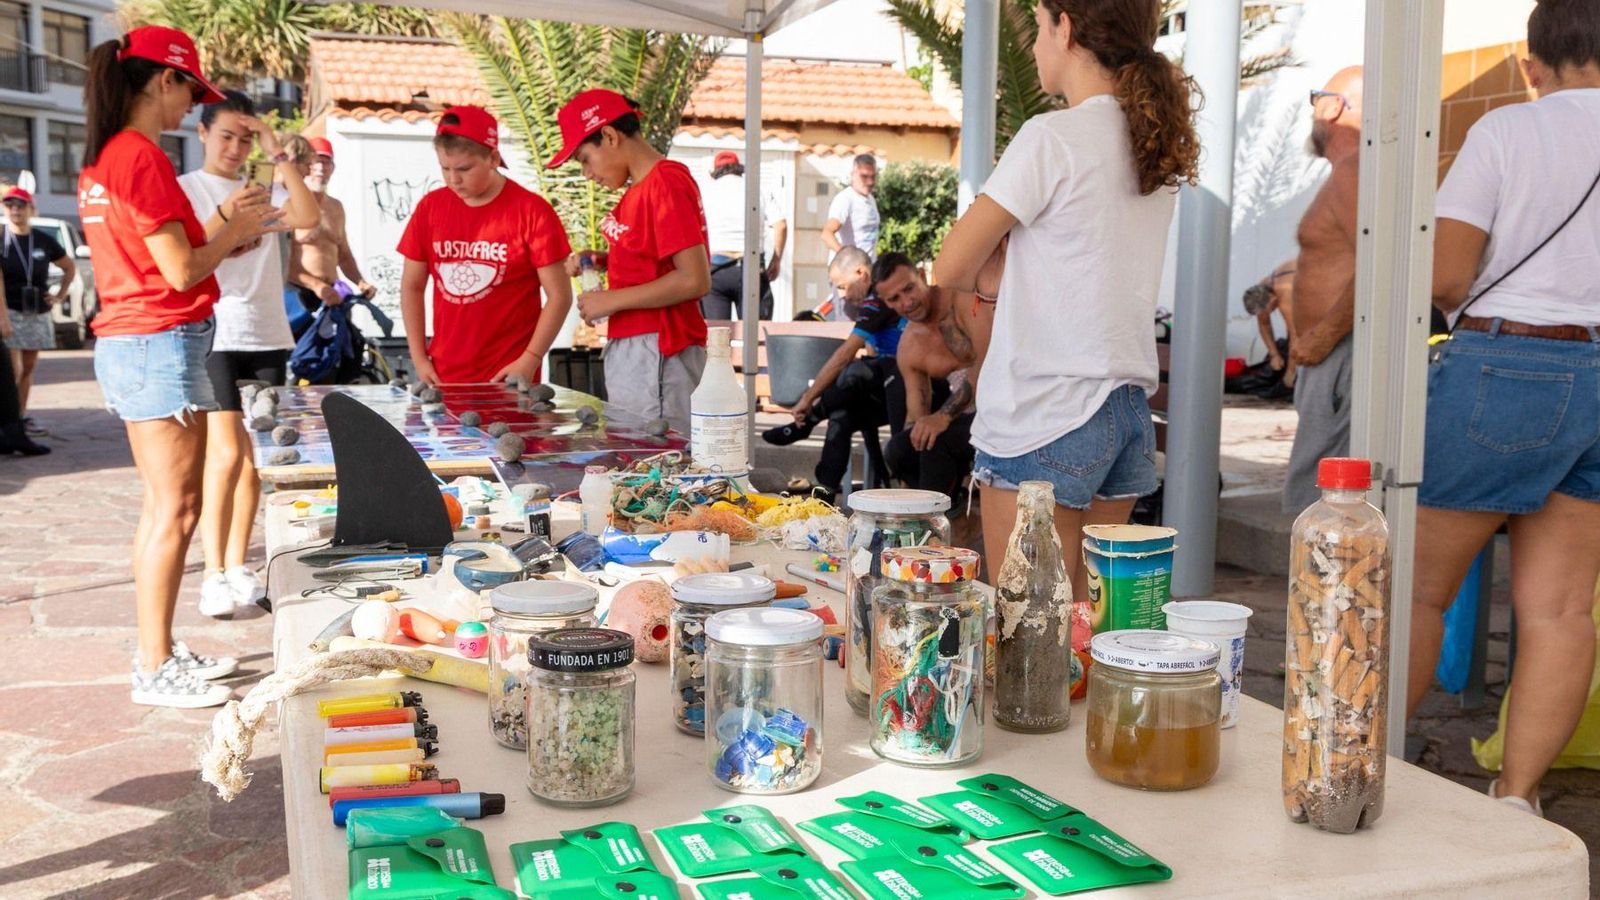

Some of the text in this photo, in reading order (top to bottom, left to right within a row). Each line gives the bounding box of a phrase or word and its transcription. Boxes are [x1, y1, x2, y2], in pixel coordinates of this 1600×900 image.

[548, 654, 594, 666] FUNDADA
[598, 654, 610, 665] EN
[613, 649, 630, 663] 1901
[1170, 660, 1196, 669] ABREFÁCIL
